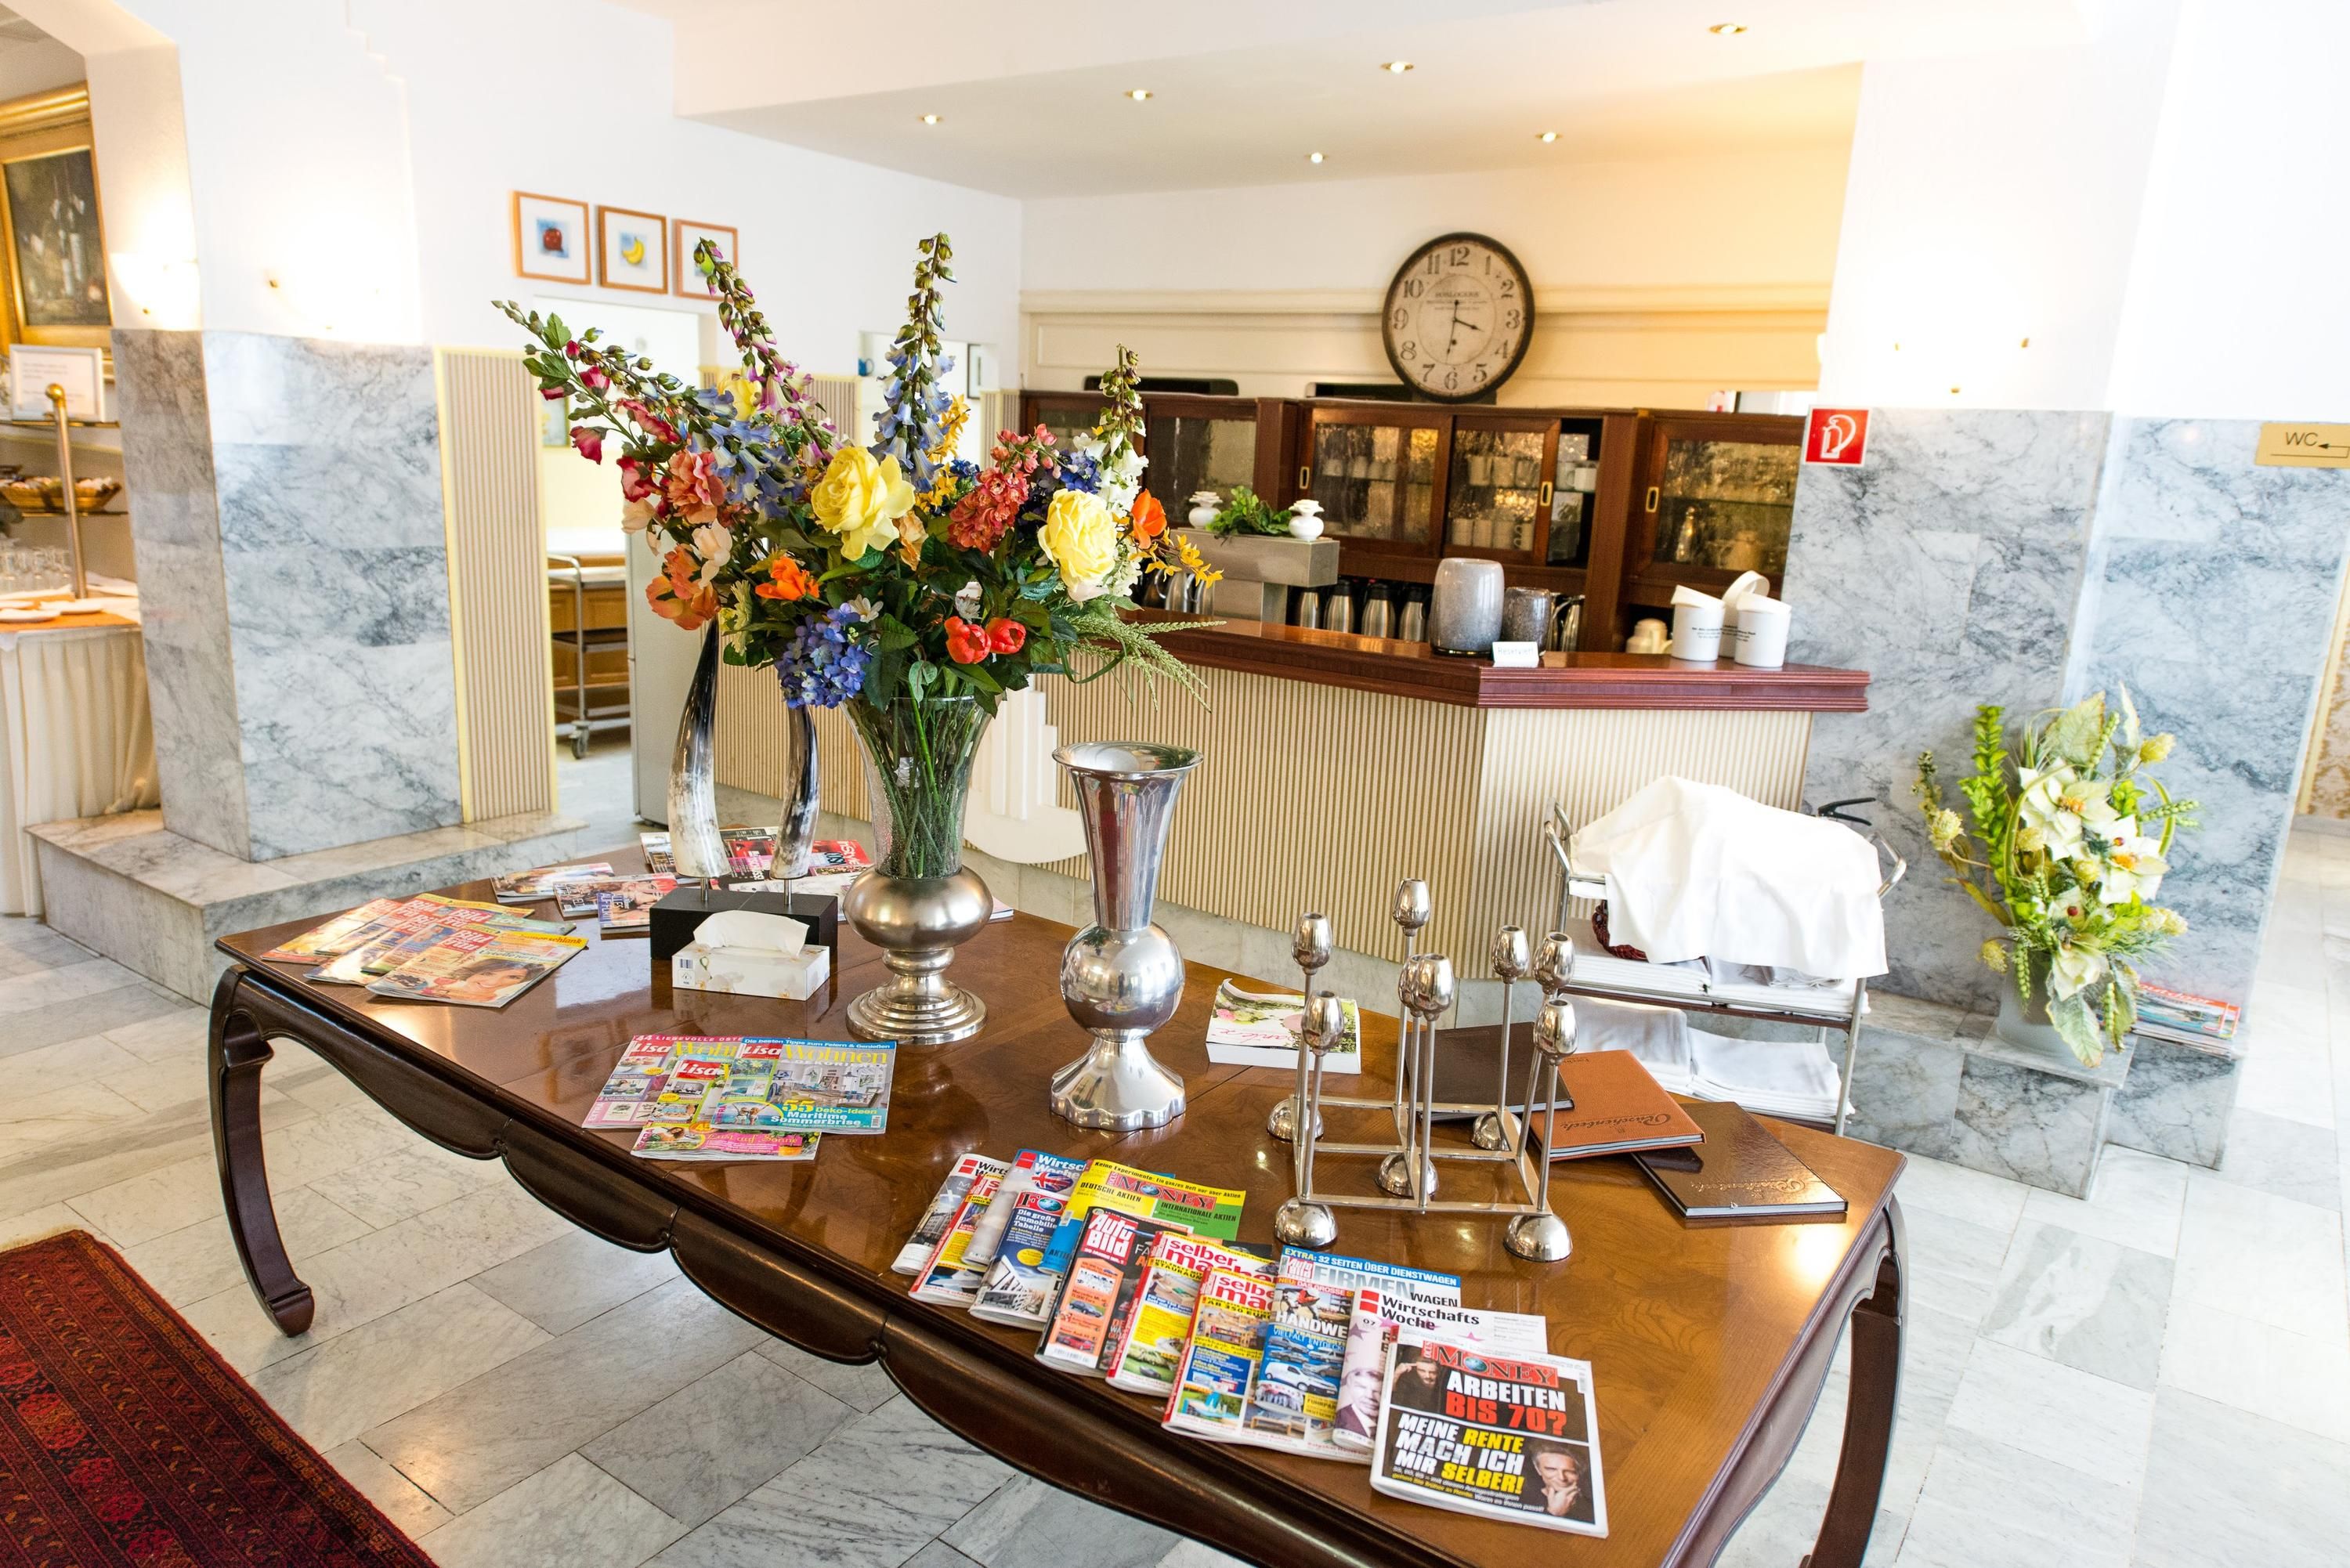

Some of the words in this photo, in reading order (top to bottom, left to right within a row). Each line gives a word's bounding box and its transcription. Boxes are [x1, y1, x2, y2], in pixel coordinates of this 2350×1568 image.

[1426, 253, 1441, 275] 11
[1450, 247, 1470, 267] 12
[1484, 255, 1491, 276] 1
[1403, 279, 1423, 299] 10
[1500, 279, 1515, 298] 2
[1394, 308, 1409, 331] 9
[1506, 309, 1521, 330] 3
[1401, 341, 1417, 360] 8
[1495, 339, 1509, 359] 4
[1423, 363, 1436, 383] 7
[1444, 370, 1459, 391] 6
[1473, 363, 1488, 383] 5
[2286, 432, 2319, 446] WC
[452, 909, 493, 923] Bild
[454, 930, 495, 943] Bild
[631, 1042, 671, 1053] Lisa
[744, 1046, 781, 1056] Lisa
[785, 1045, 887, 1064] Wohnen
[678, 1062, 718, 1076] Lisa
[782, 1100, 815, 1113] 55
[771, 1116, 862, 1125] Sommerbrise
[1080, 1182, 1116, 1197] DEUTSCHE
[1117, 1191, 1141, 1203] AKTIEN
[1119, 1176, 1212, 1208] MONEY
[1165, 1180, 1184, 1189] ganzes
[1032, 1213, 1056, 1223] große
[1161, 1201, 1213, 1219] INTERNATIONALE
[1213, 1213, 1237, 1223] AKTIEN
[1014, 1220, 1044, 1233] Tabelle
[1088, 1213, 1136, 1241] Auto
[1086, 1230, 1130, 1258] Bild
[1169, 1239, 1238, 1266] selber
[1283, 1248, 1318, 1263] EXTRA:
[1318, 1255, 1331, 1264] 32
[1331, 1256, 1363, 1270] SEITEN
[1364, 1261, 1390, 1274] ÜBER
[1390, 1266, 1458, 1286] DIENSTWAGEN
[1313, 1266, 1415, 1299] FIRMEN
[1410, 1292, 1458, 1307] WAGEN
[1380, 1306, 1435, 1331] Woche
[1382, 1295, 1480, 1326] Wirtschafts
[1273, 1327, 1306, 1342] VIELFALT
[1436, 1346, 1556, 1386] MONEY
[1446, 1371, 1567, 1412] ARBEITEN
[1444, 1391, 1499, 1425] BIS
[1508, 1405, 1567, 1437] 70?
[1397, 1413, 1460, 1442] MEINE
[1462, 1429, 1525, 1454] RENTE
[1394, 1432, 1473, 1466] MACH
[1477, 1449, 1525, 1476] ICH
[1394, 1451, 1438, 1475] MIR
[1441, 1462, 1526, 1494] SELBER!
